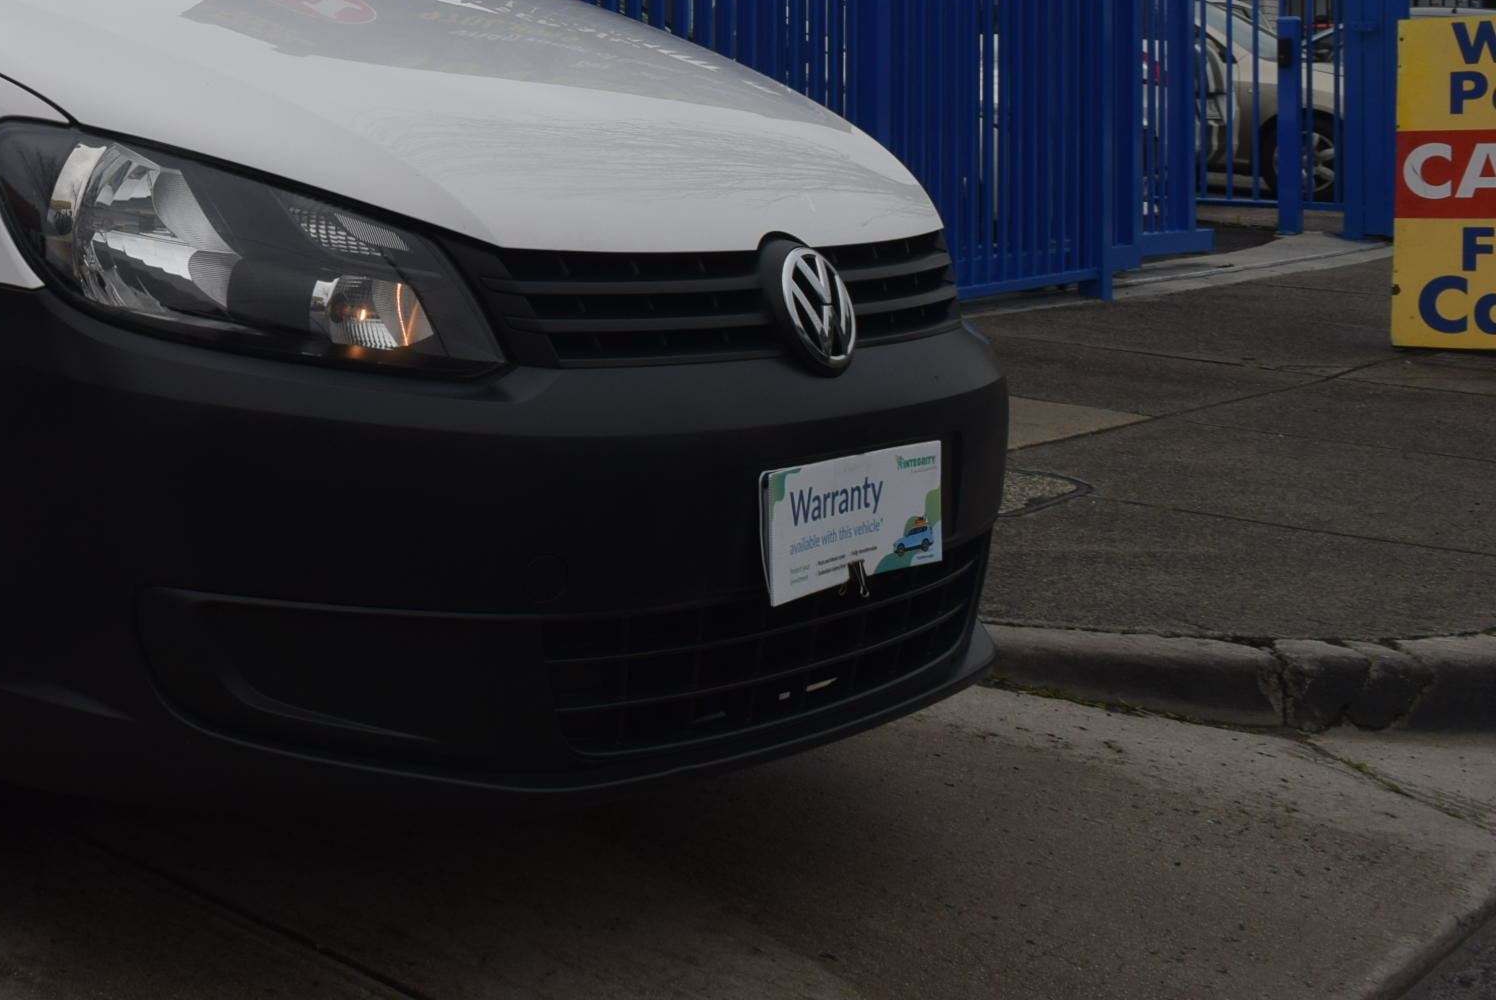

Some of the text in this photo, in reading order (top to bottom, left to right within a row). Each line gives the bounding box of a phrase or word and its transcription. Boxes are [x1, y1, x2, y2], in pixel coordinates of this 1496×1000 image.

[789, 477, 883, 527] Warranty
[789, 535, 820, 556] available
[821, 530, 837, 549] with
[838, 525, 852, 541] this
